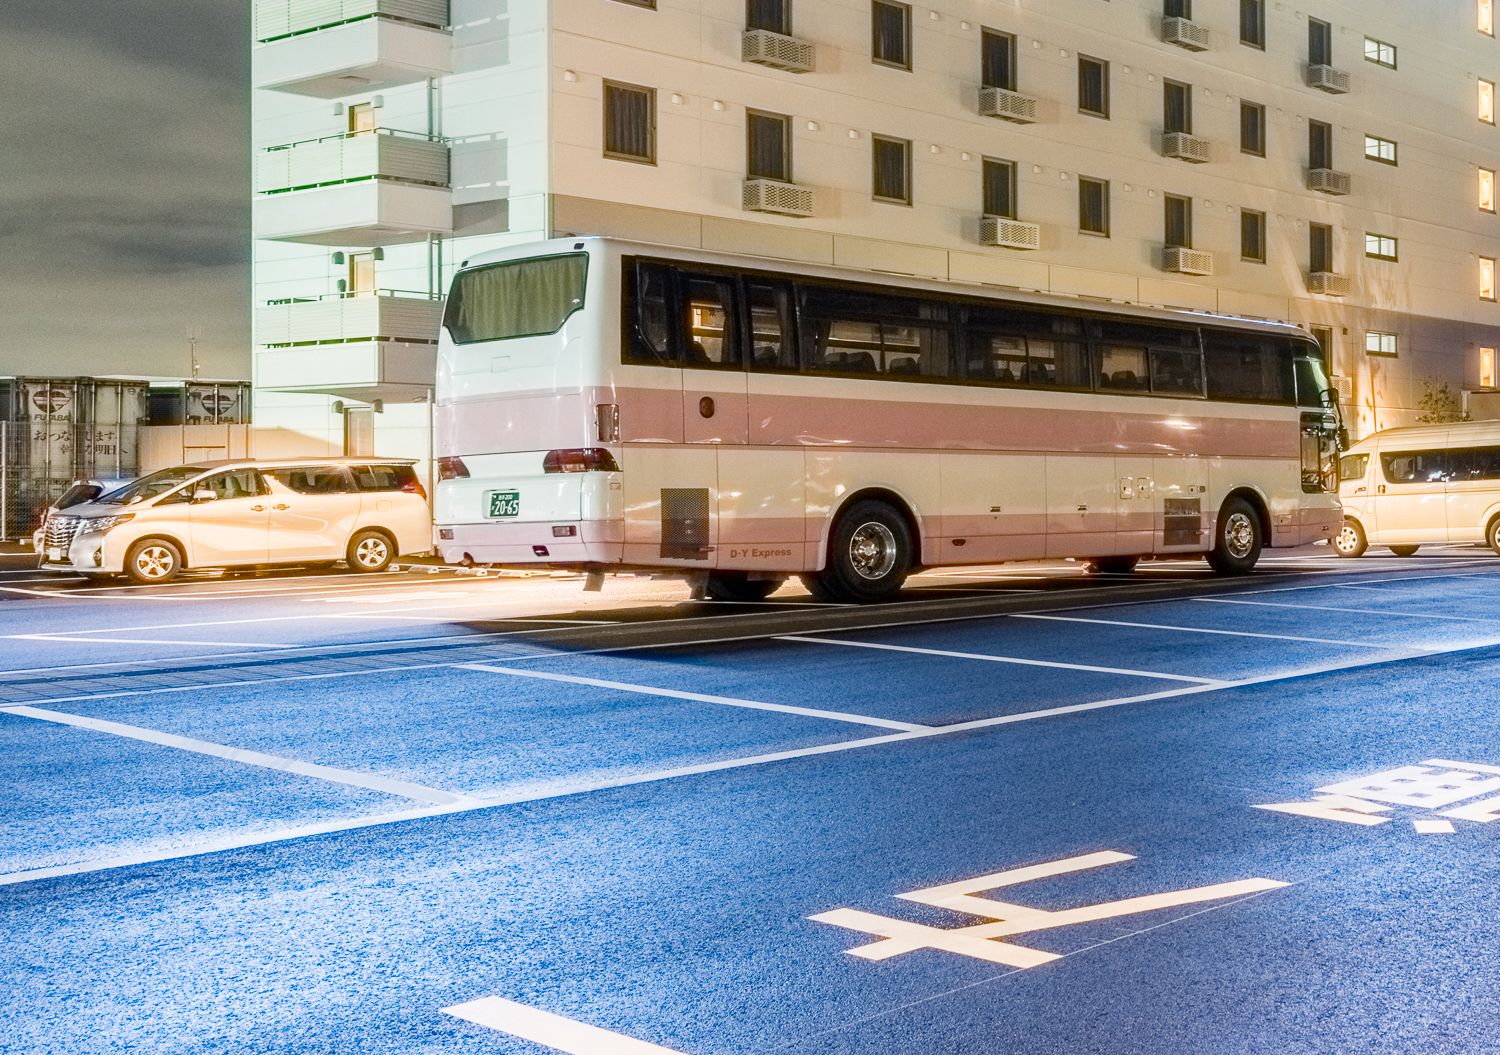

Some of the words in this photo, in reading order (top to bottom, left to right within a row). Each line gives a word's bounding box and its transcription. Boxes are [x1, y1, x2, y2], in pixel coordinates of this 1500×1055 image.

[33, 414, 71, 422] FUABA
[33, 430, 116, 442] おつなします
[60, 444, 128, 455] 幸な明日へ
[494, 500, 519, 515] 20-65
[751, 548, 792, 559] Express
